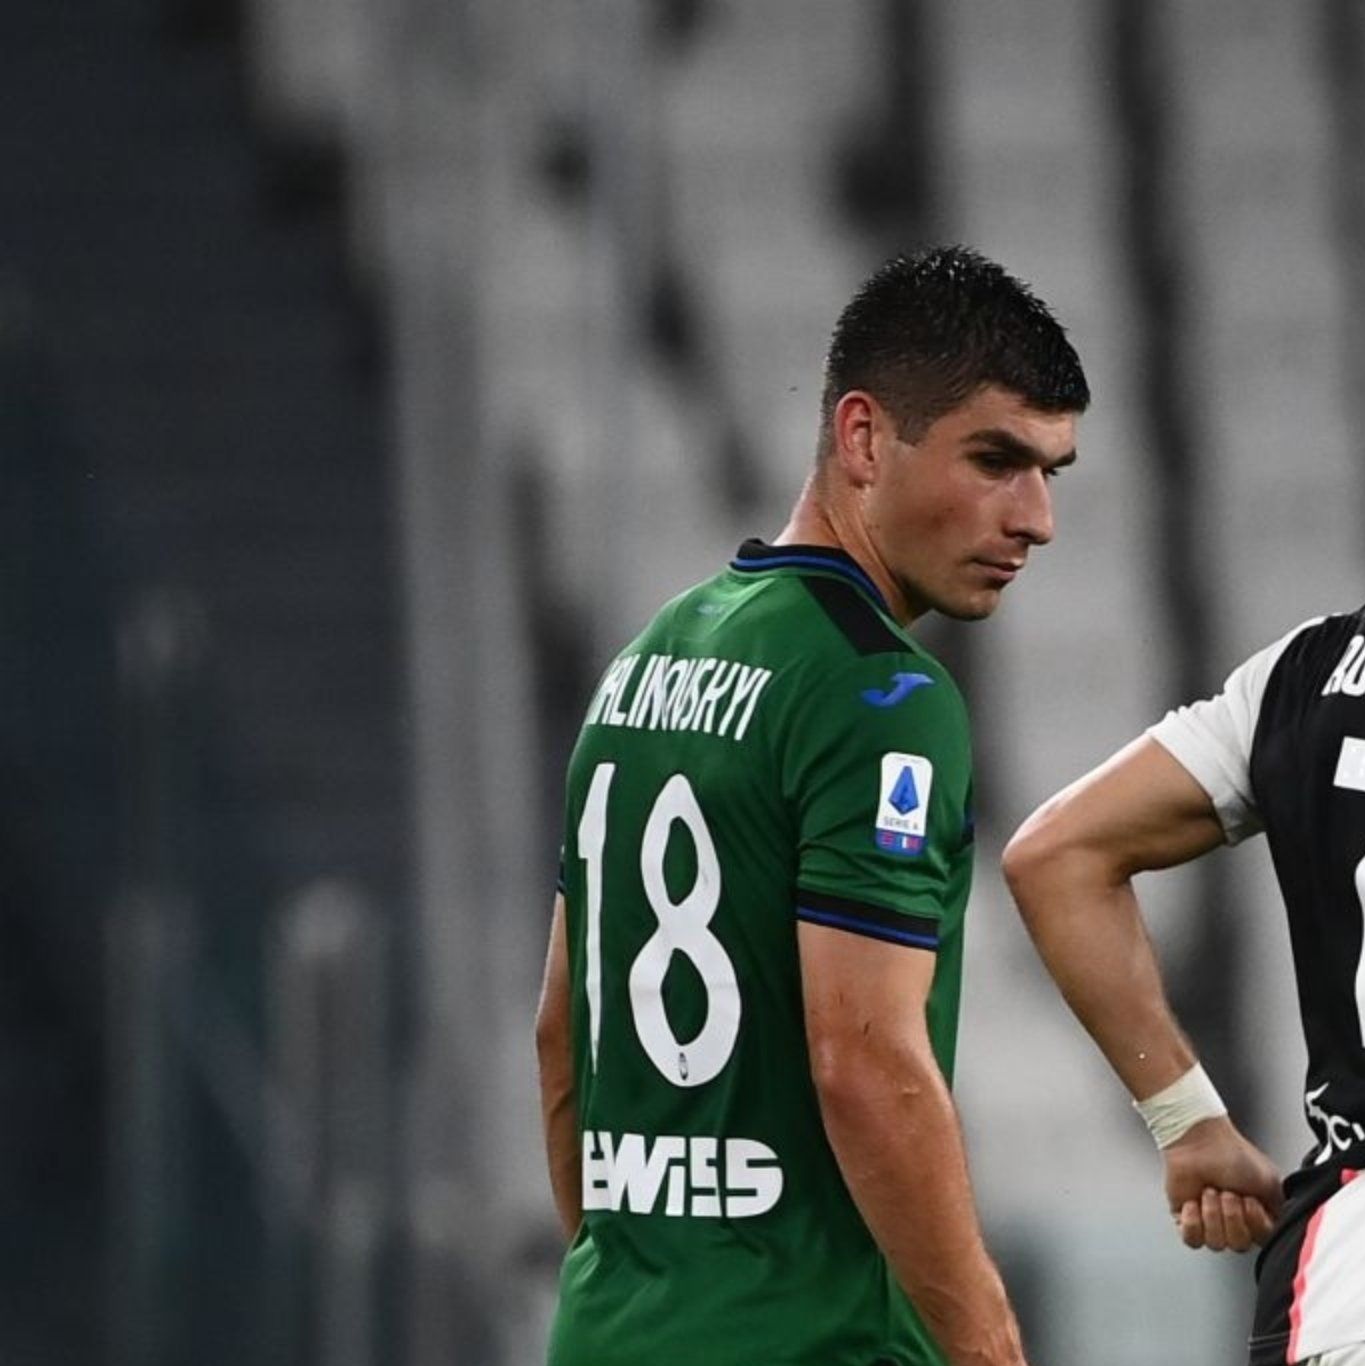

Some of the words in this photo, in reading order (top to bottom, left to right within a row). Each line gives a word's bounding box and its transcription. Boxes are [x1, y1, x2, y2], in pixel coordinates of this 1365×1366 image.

[586, 653, 773, 741] ALINOVSKYI
[577, 761, 742, 1088] 18
[581, 1129, 784, 1219] EWISS
